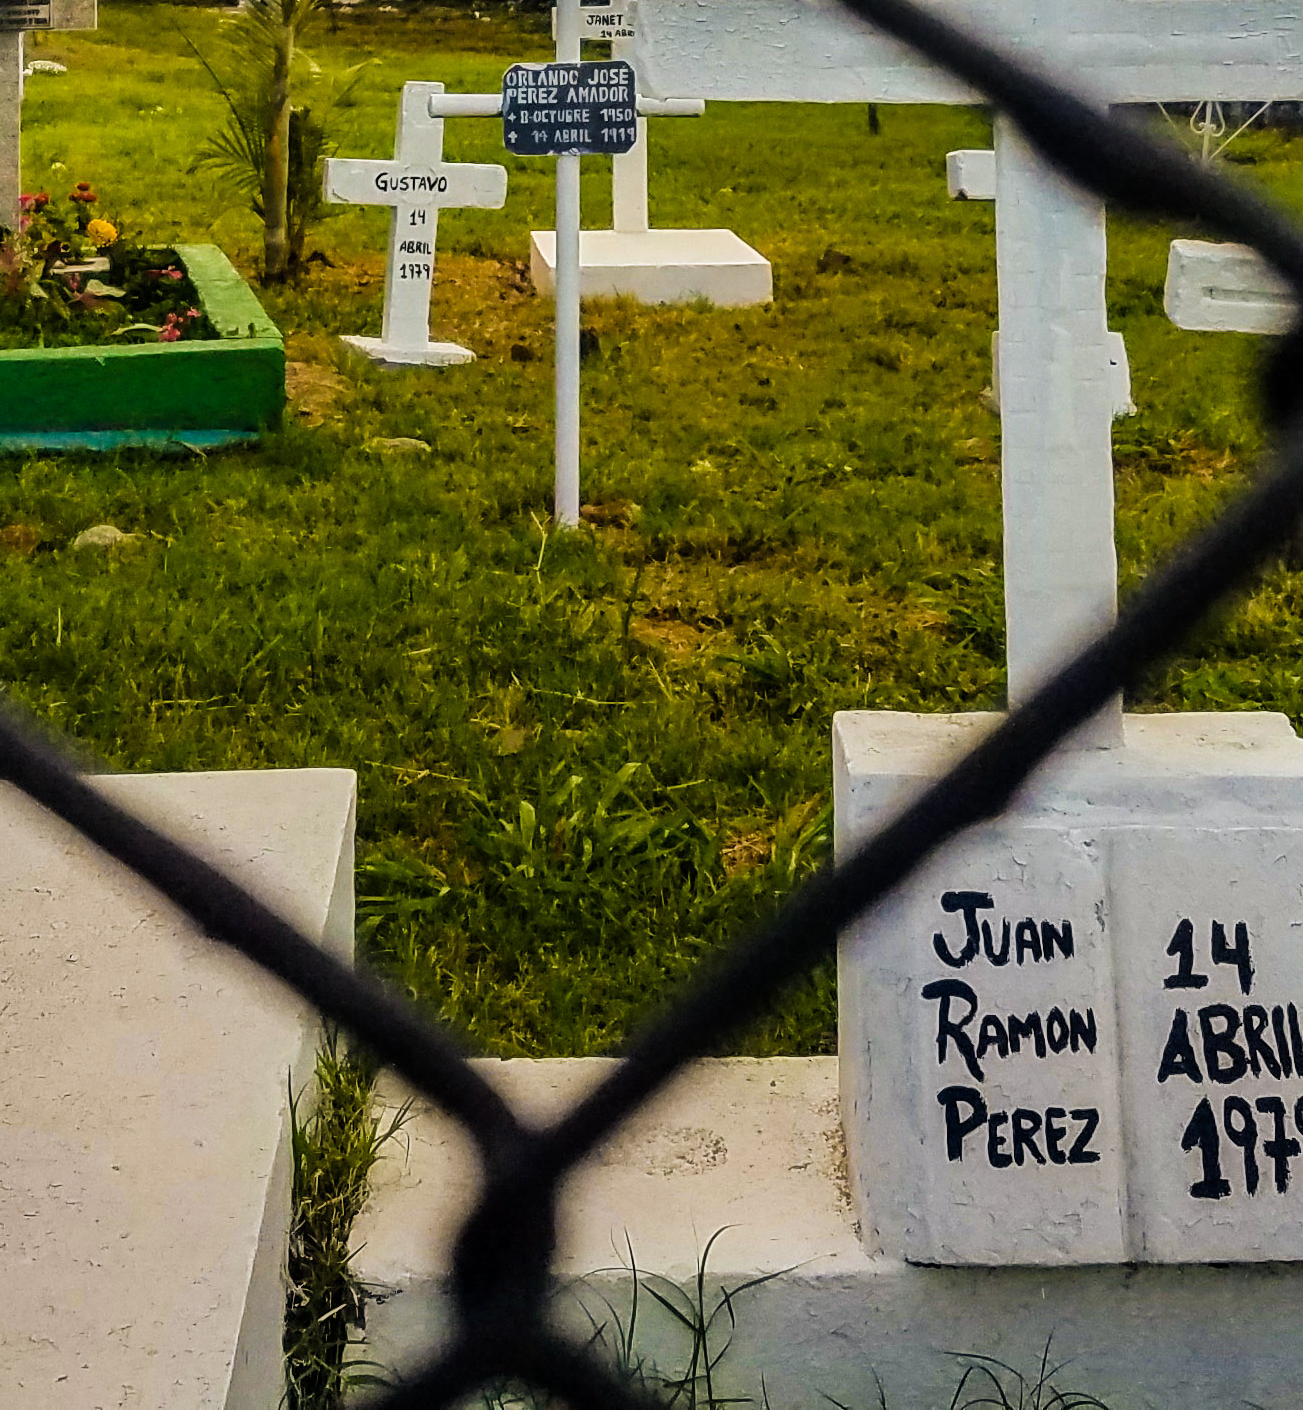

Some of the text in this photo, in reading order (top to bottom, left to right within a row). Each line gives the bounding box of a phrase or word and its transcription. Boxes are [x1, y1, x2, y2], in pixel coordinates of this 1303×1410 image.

[586, 14, 623, 26] JANET
[600, 29, 612, 37] 14
[505, 70, 579, 87] ORLANDO
[566, 85, 629, 103] AMADOR
[599, 108, 632, 122] 1950
[531, 130, 548, 143] 14
[554, 129, 592, 143] ABRIL
[375, 172, 447, 192] GUSTAVO
[410, 209, 425, 225] 14
[399, 241, 431, 254] ABRIL
[399, 263, 430, 279] 1979
[1163, 918, 1254, 995] 14
